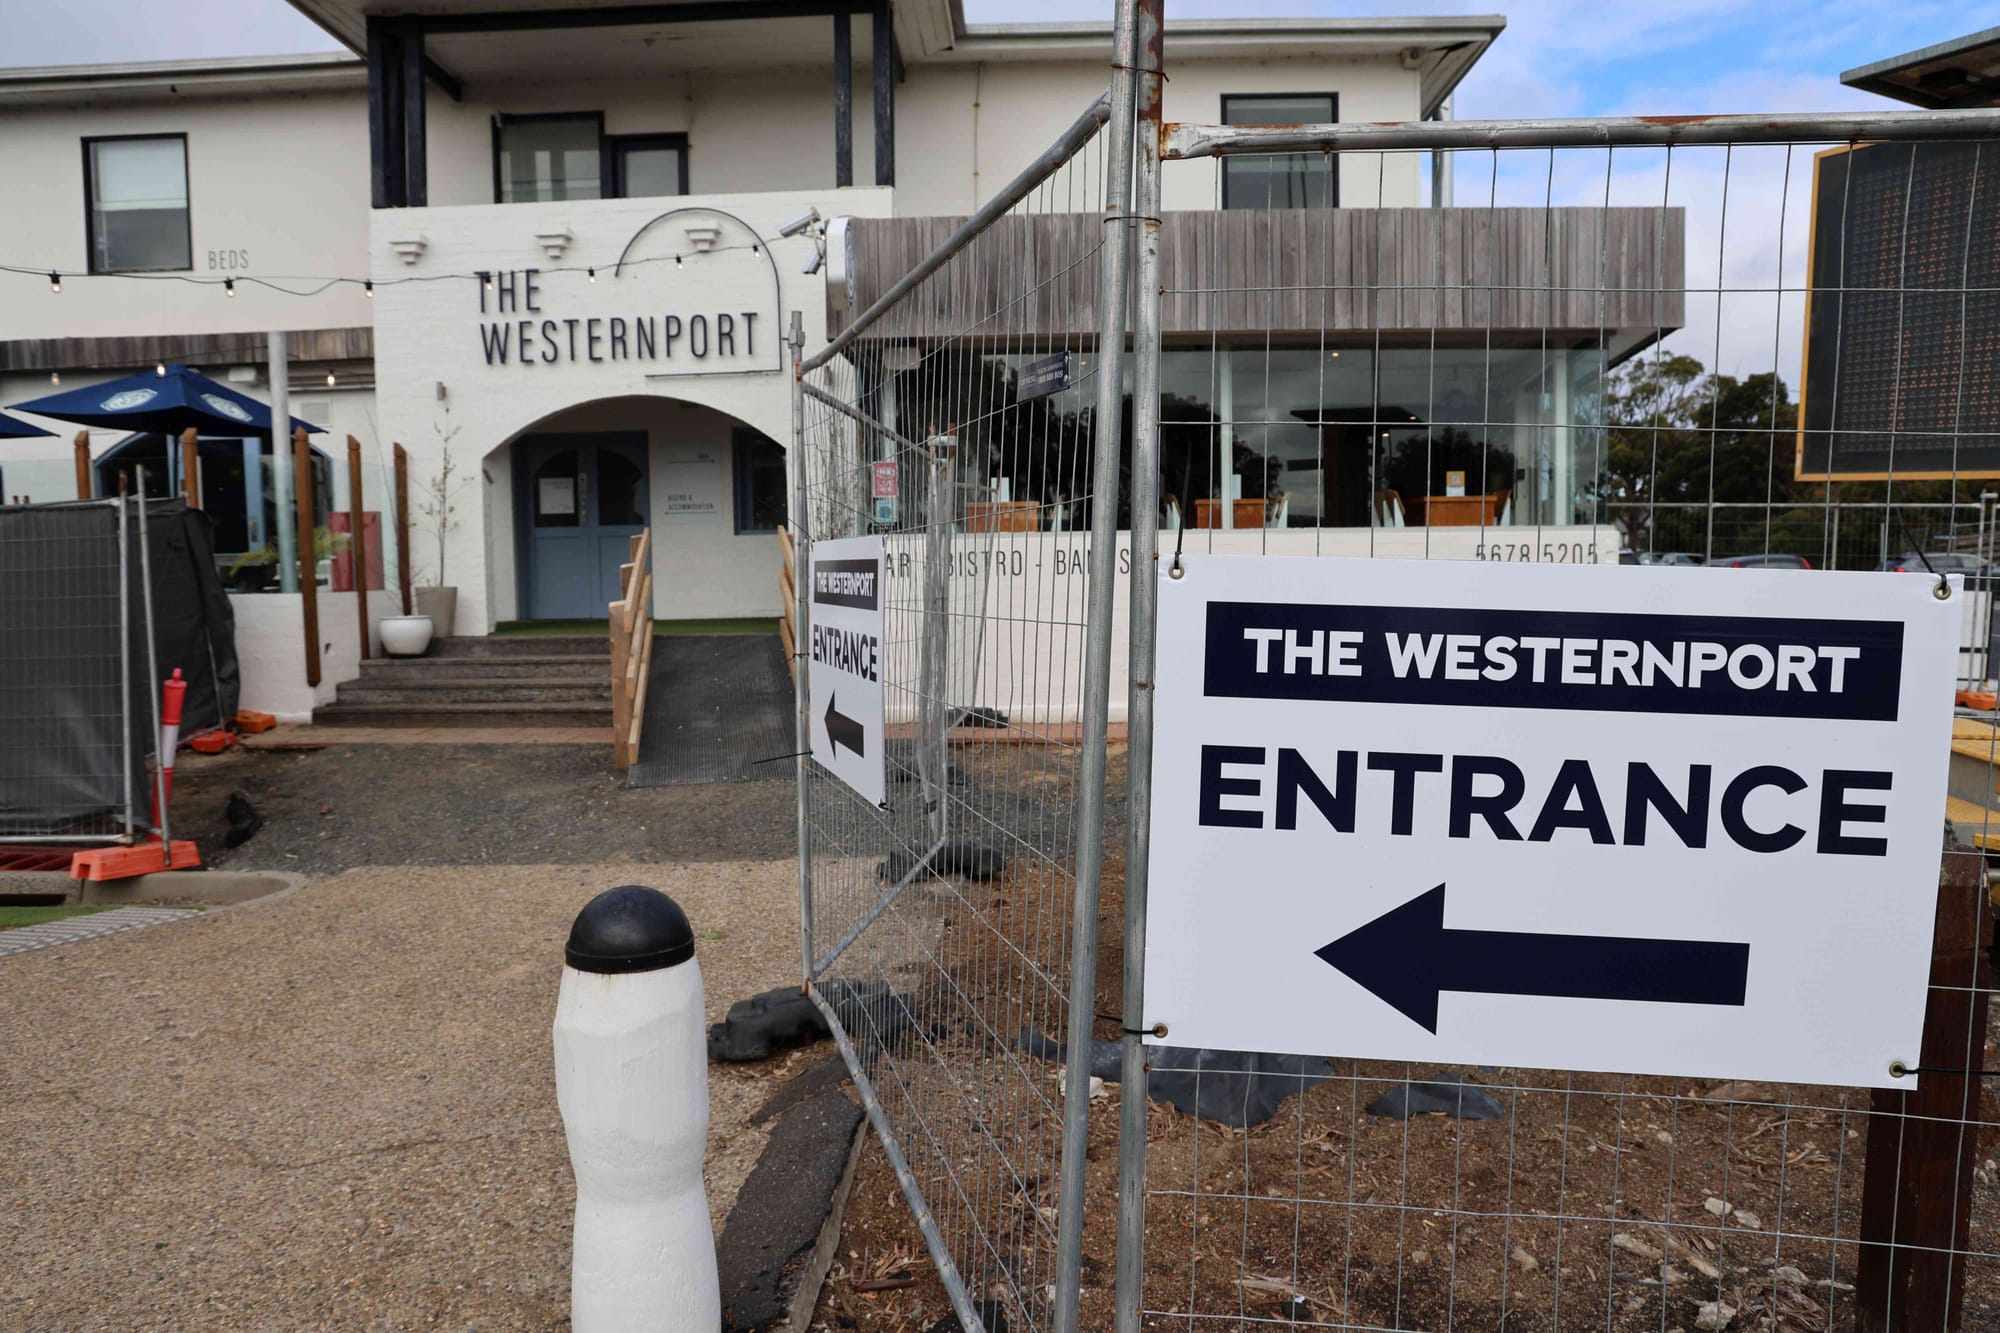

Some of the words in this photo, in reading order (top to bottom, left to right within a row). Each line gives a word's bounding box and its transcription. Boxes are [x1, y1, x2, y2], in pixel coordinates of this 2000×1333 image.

[208, 249, 249, 270] BEDS
[474, 269, 541, 313] THE
[480, 312, 758, 366] WESTERNPORT
[1056, 548, 1130, 576] BAS
[1476, 543, 1530, 562] 5678
[1544, 543, 1598, 564] 5205
[816, 571, 828, 593] THE
[828, 571, 875, 597] WESTERNPORT
[813, 623, 878, 683] ENTRANCE
[1243, 628, 1364, 677] THE
[1384, 632, 1861, 694] WESTERNPORT
[1198, 744, 1894, 857] ENTRANCE
